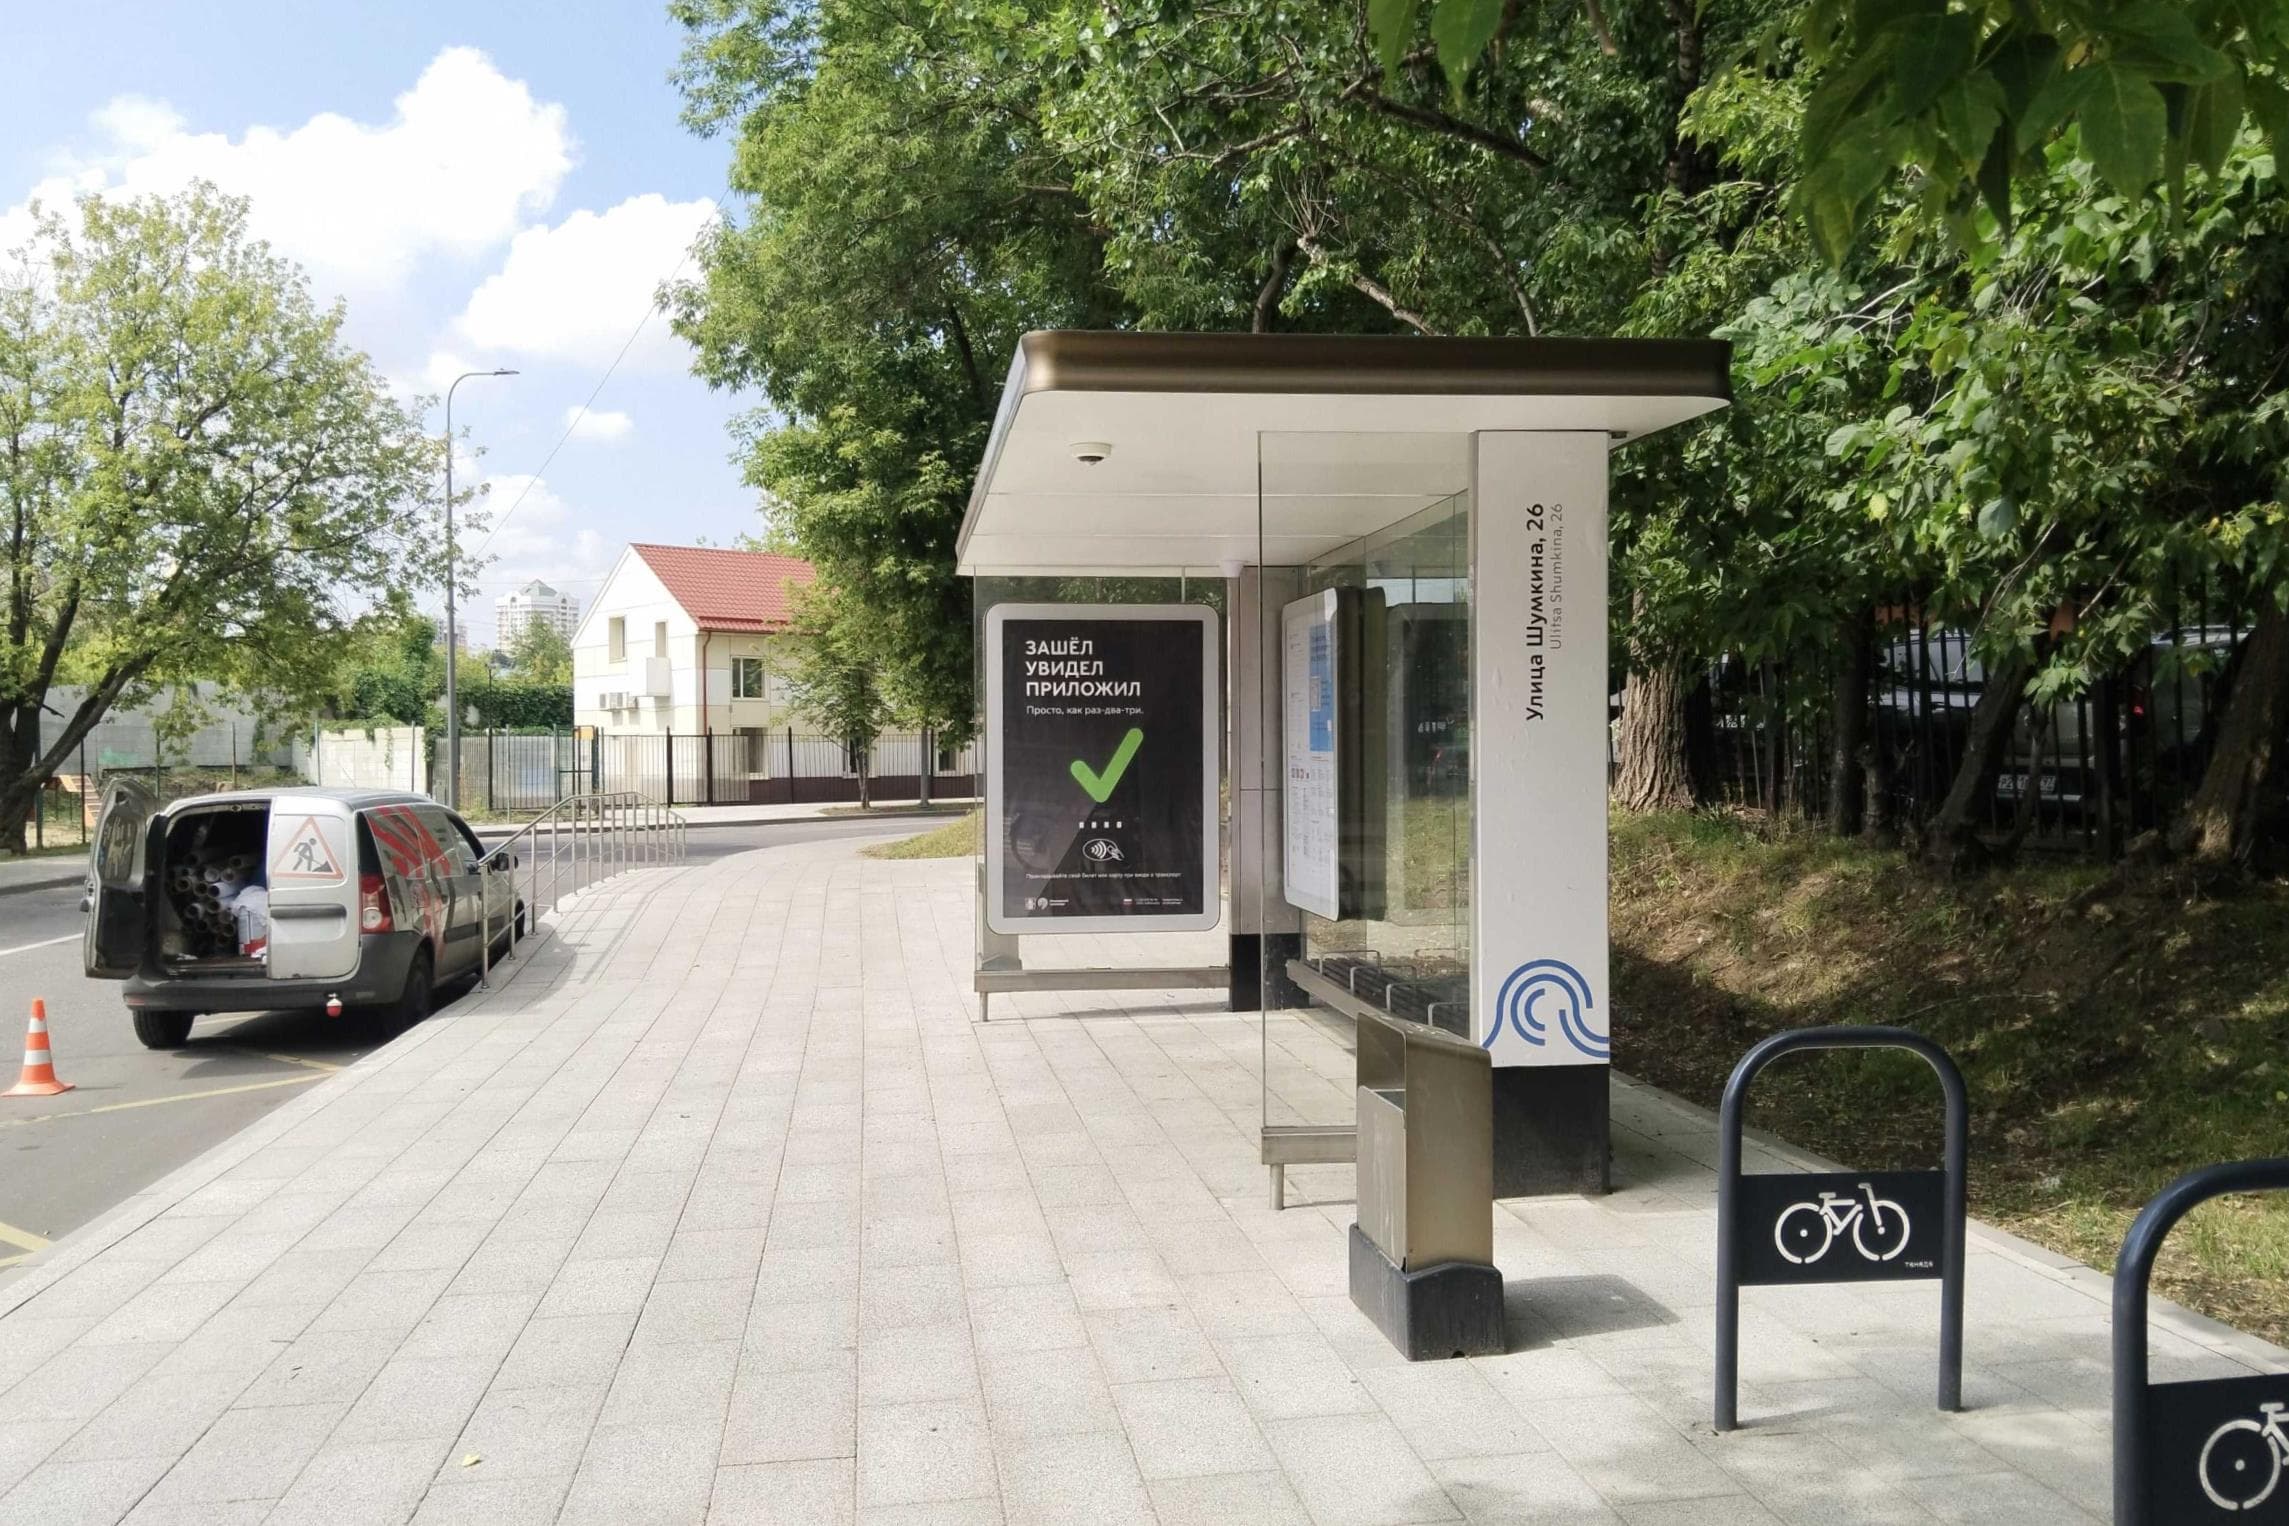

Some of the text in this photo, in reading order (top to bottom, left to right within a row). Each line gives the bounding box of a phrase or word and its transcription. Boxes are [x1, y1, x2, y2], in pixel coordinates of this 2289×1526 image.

[1549, 503, 1564, 650] Ulitsa Shumkina, 26
[1526, 503, 1547, 721] Улица Шумкина, 26
[1025, 636, 1093, 656] ЗАШЁЛ
[1025, 660, 1104, 679] УВИДЕЛ
[1025, 681, 1141, 697] ПРИЛОЖИЛ
[1026, 705, 1065, 717] Просто,
[1066, 706, 1083, 715] как
